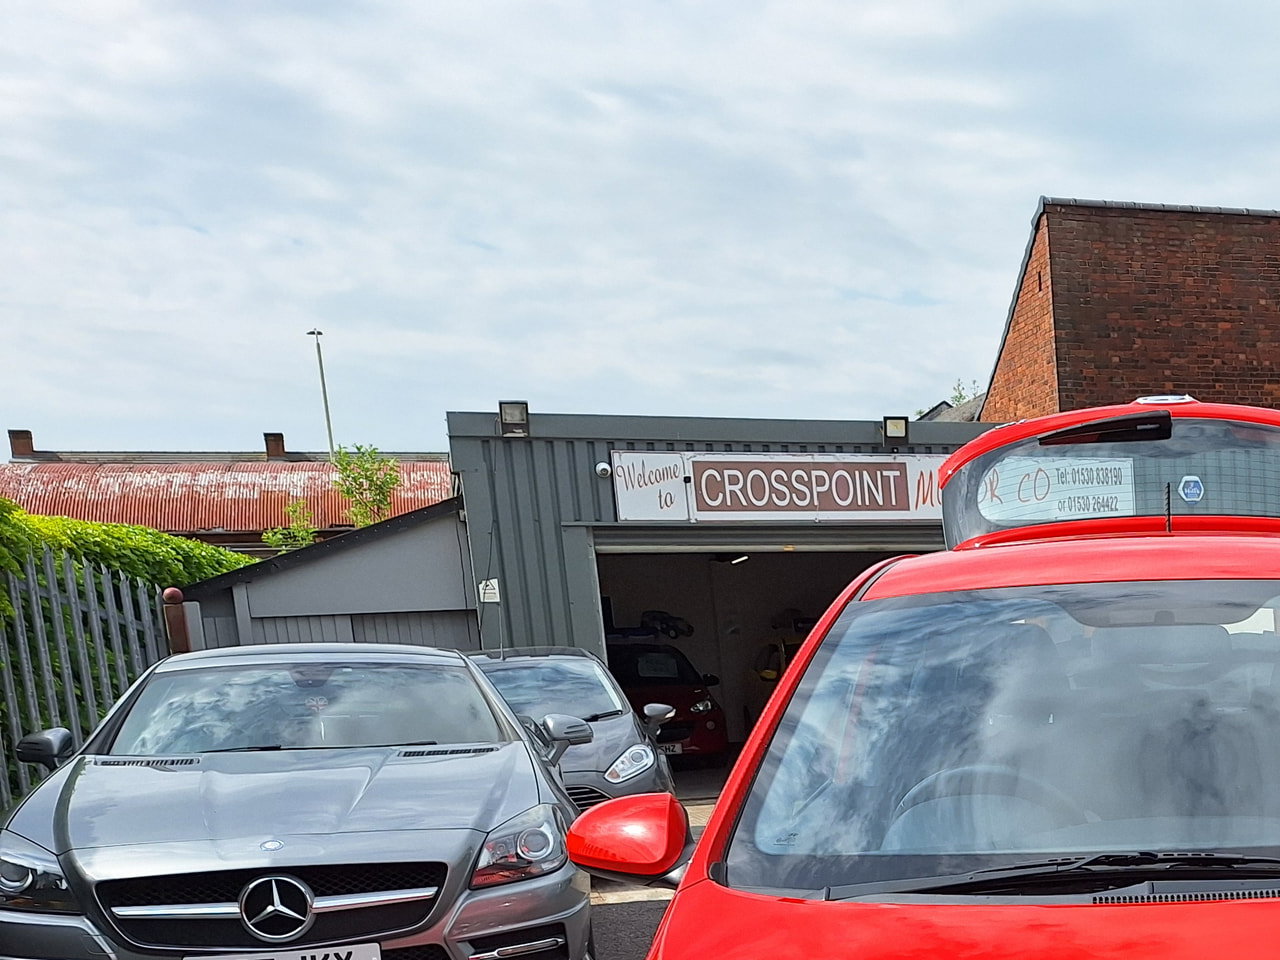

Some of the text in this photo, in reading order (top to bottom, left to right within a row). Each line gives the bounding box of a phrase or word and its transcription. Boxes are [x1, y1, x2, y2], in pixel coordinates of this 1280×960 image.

[616, 460, 680, 491] Welcome
[1056, 467, 1122, 485] Tel: 01530 838190
[701, 469, 900, 507] CROSSPOINT
[1018, 468, 1050, 503] CO
[658, 489, 674, 509] to
[1058, 496, 1118, 512] or 01530 264422
